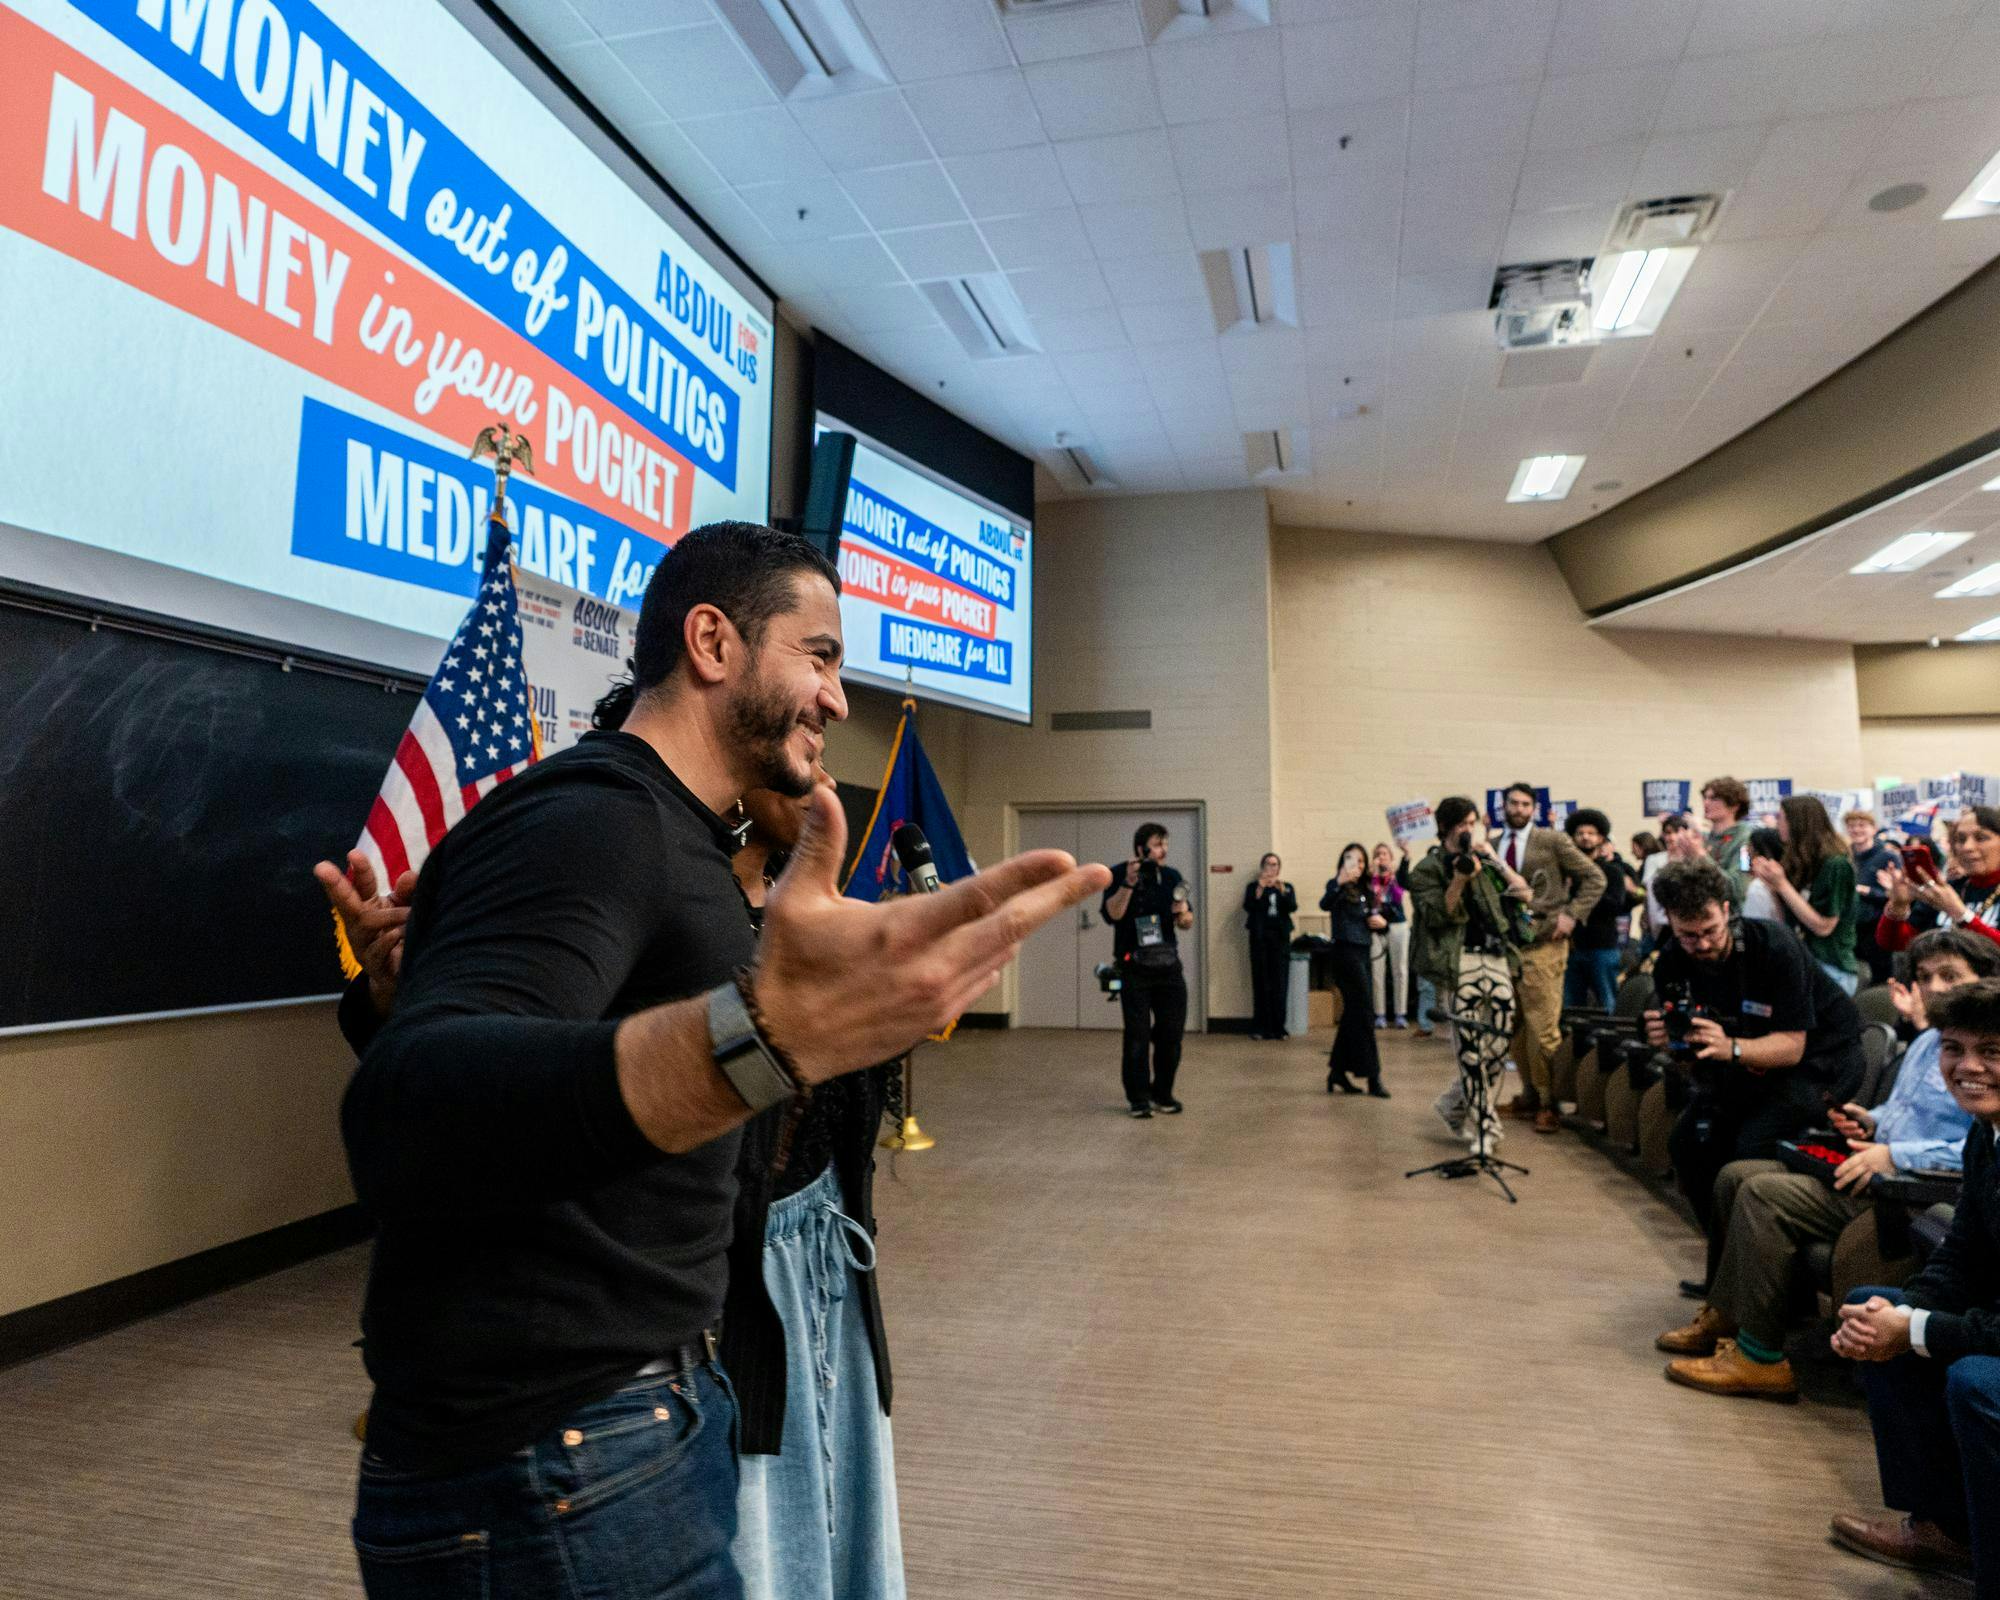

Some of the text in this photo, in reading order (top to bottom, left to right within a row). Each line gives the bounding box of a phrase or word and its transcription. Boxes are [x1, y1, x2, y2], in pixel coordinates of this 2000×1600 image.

[42, 71, 679, 530] MONEY in your POCKET
[425, 187, 513, 276] out
[511, 244, 571, 338] of
[574, 275, 726, 463] POLITICS
[655, 249, 735, 367] ABDUL
[738, 347, 757, 384] US
[844, 487, 907, 549] MONEY
[906, 528, 931, 556] out
[930, 535, 949, 574] of
[950, 543, 1011, 602] POLITICS
[979, 519, 1012, 557] ABDUL
[573, 596, 620, 638] ABDUL
[891, 566, 909, 597] in
[905, 580, 941, 611] your
[941, 587, 992, 634] POCKET
[584, 630, 619, 659] SENATE
[889, 621, 1008, 675] MEDICARE for ALL
[528, 685, 558, 720] DUL
